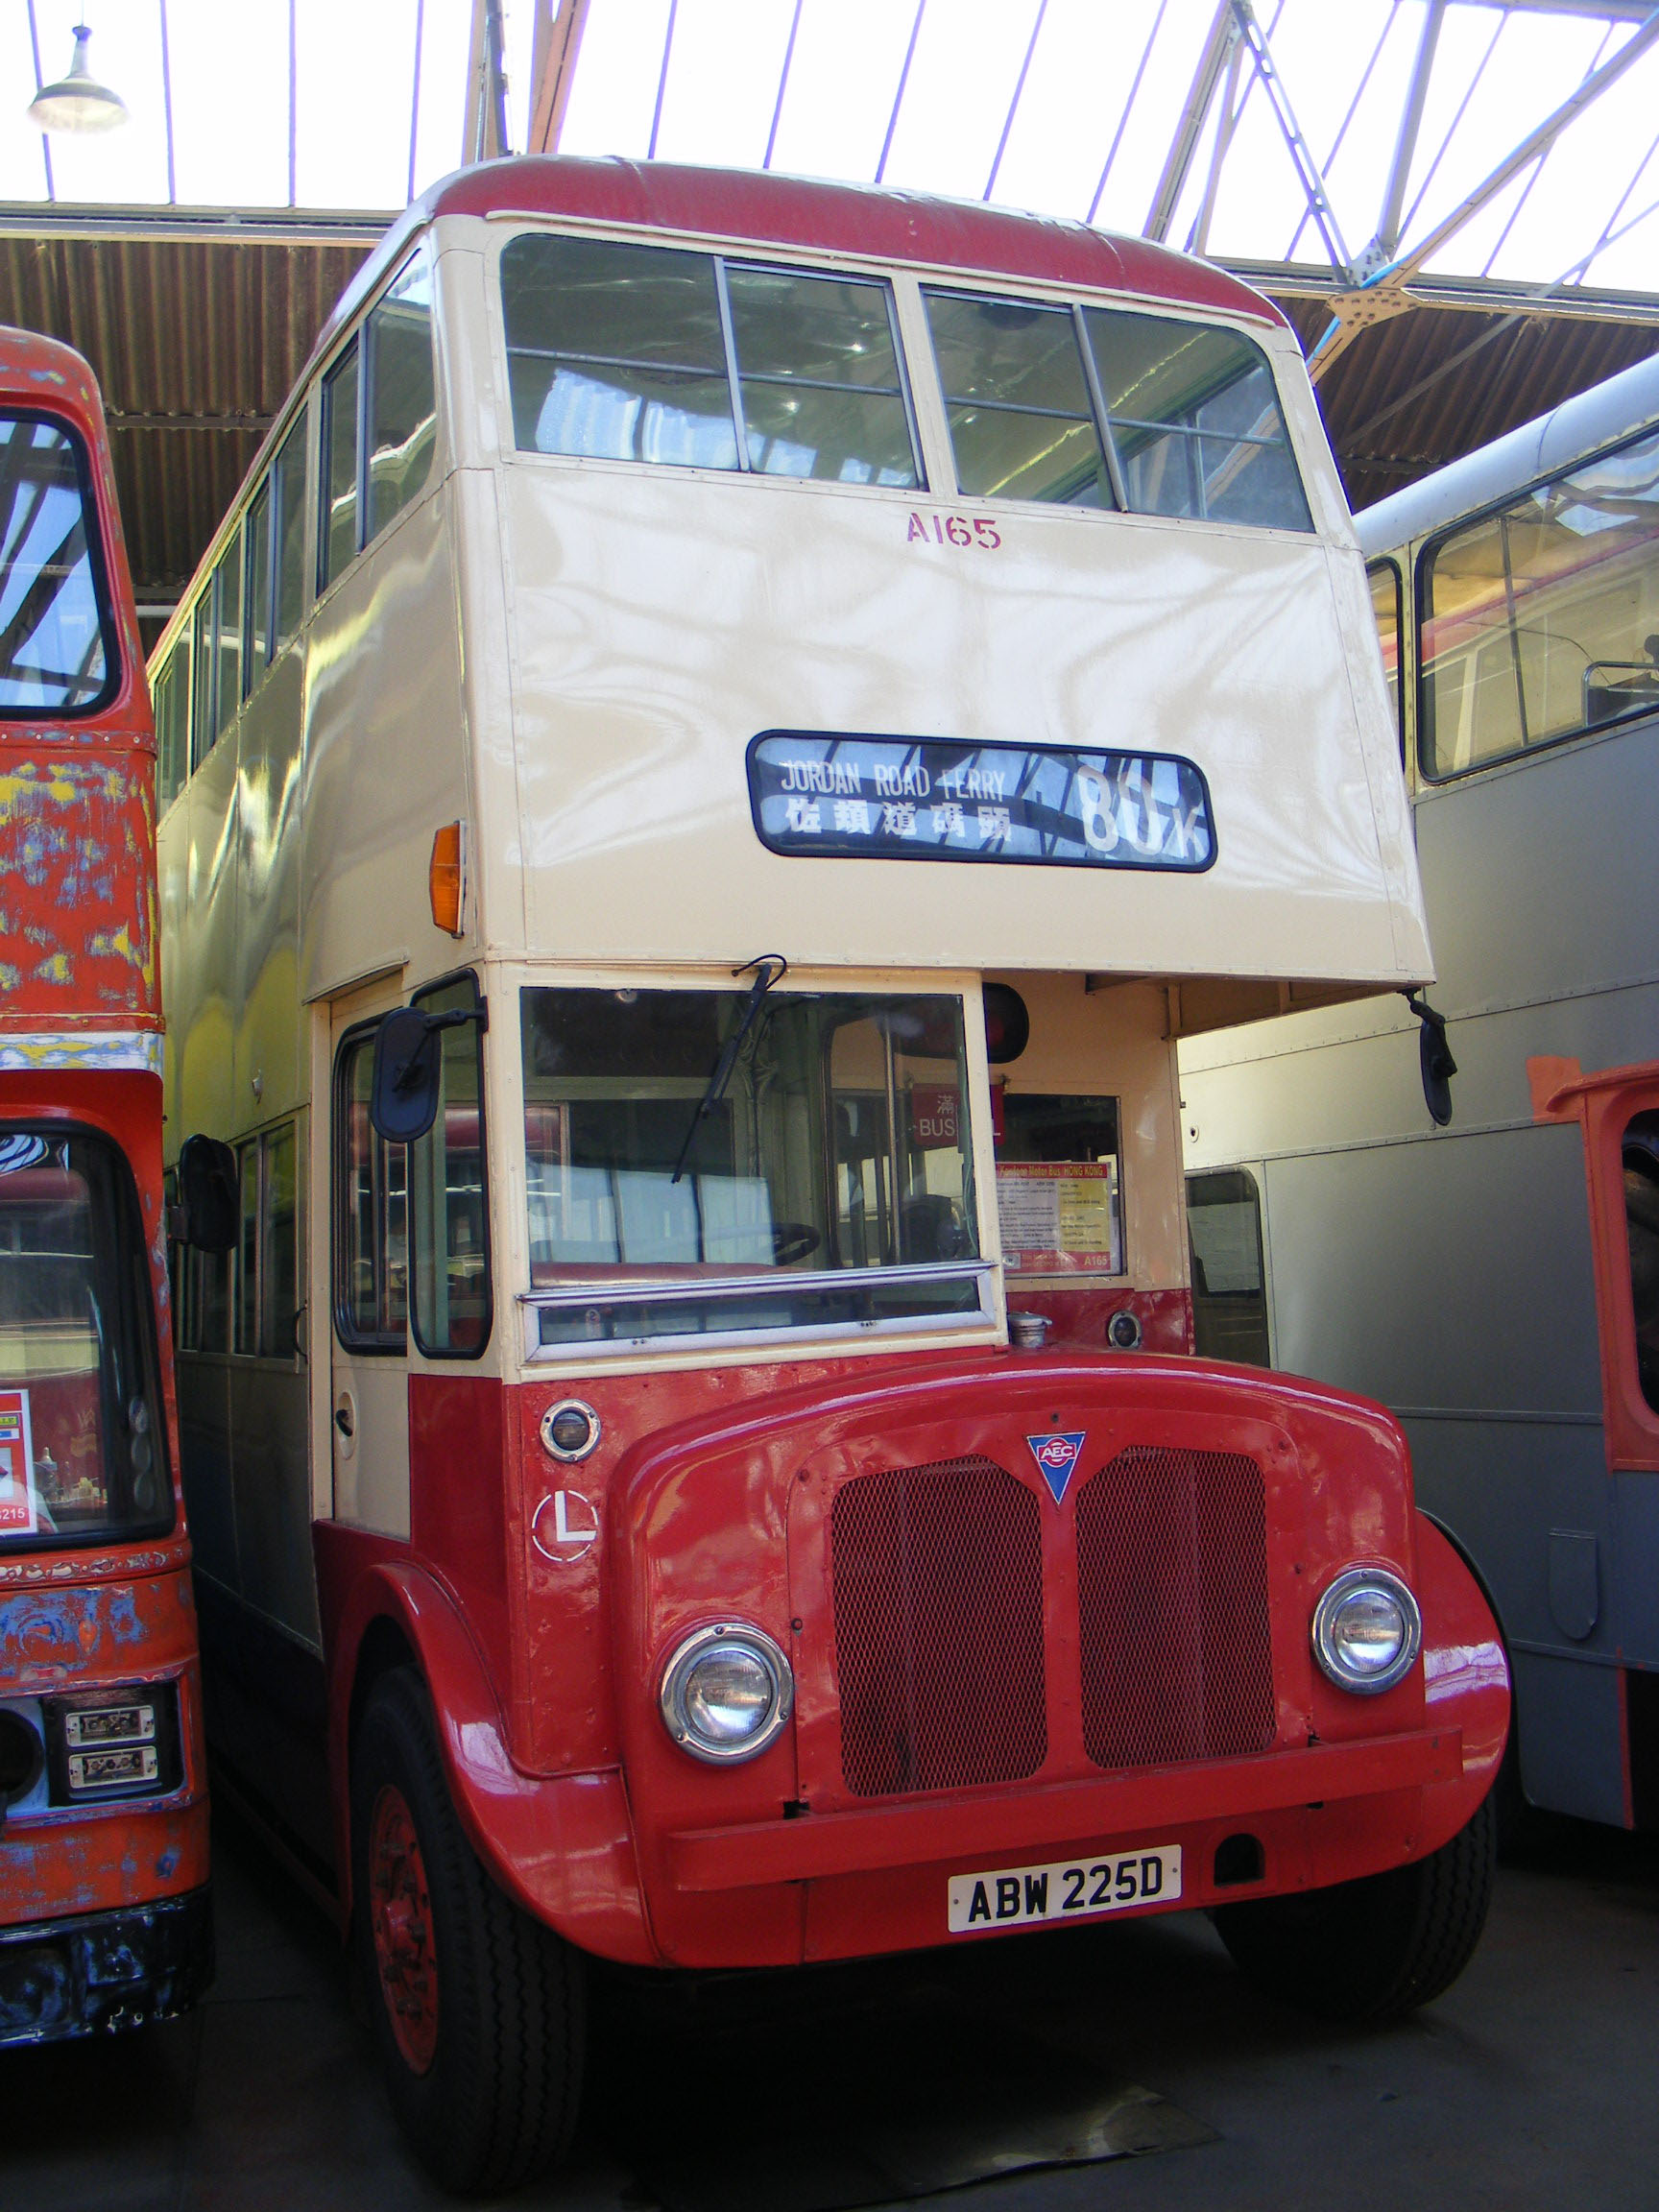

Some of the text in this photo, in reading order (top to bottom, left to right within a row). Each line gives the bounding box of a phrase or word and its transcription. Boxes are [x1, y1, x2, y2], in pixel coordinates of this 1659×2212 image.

[907, 512, 1001, 549] A165
[780, 759, 1006, 803] JORDAN ROAD FERRY
[919, 1118, 955, 1137] BUS
[1048, 1164, 1061, 1176] Bus
[1064, 1165, 1083, 1176] HONG
[1084, 1165, 1103, 1176] KONG
[1041, 1445, 1073, 1459] AEC
[0, 1507, 25, 1520] 215
[554, 1489, 596, 1542] L
[968, 1856, 1163, 1923] ABW 225D
